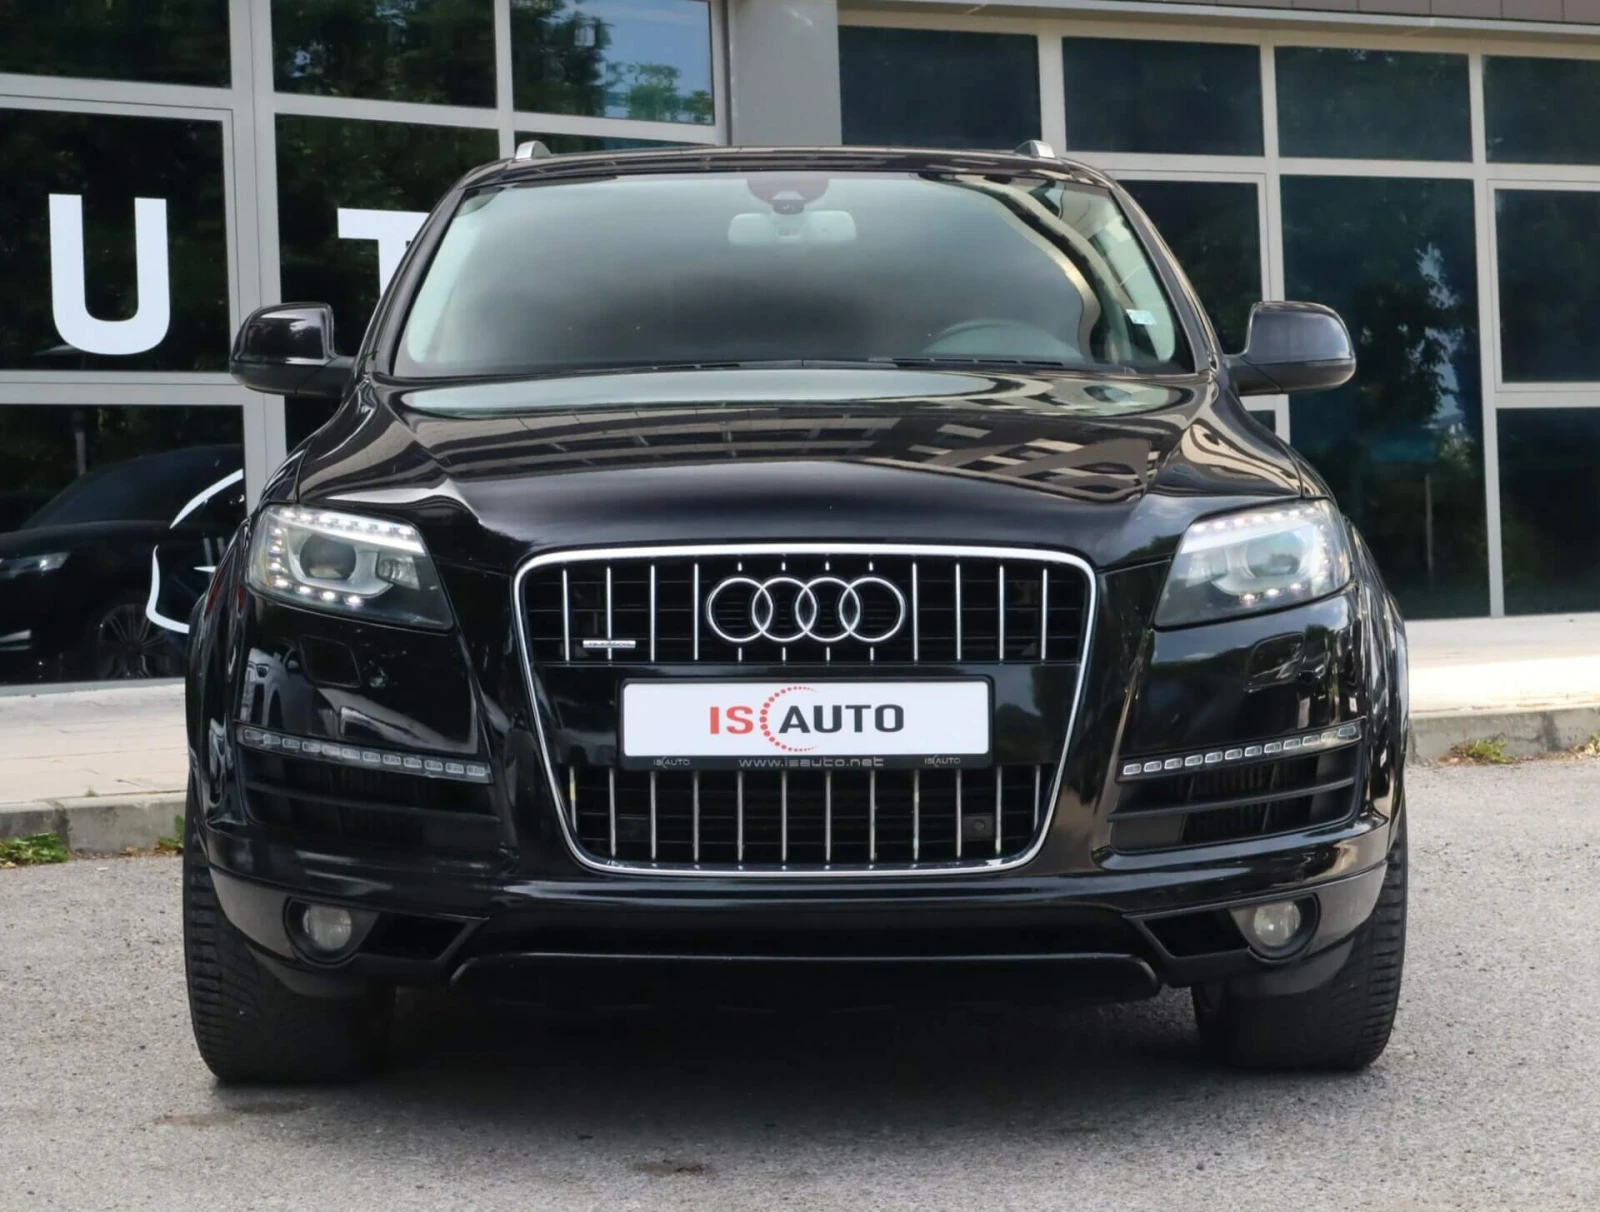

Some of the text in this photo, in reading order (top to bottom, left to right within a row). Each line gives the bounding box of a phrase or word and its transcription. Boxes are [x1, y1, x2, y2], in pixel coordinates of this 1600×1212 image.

[710, 704, 904, 734] IS AUTO
[738, 757, 884, 767] www.isauto.net
